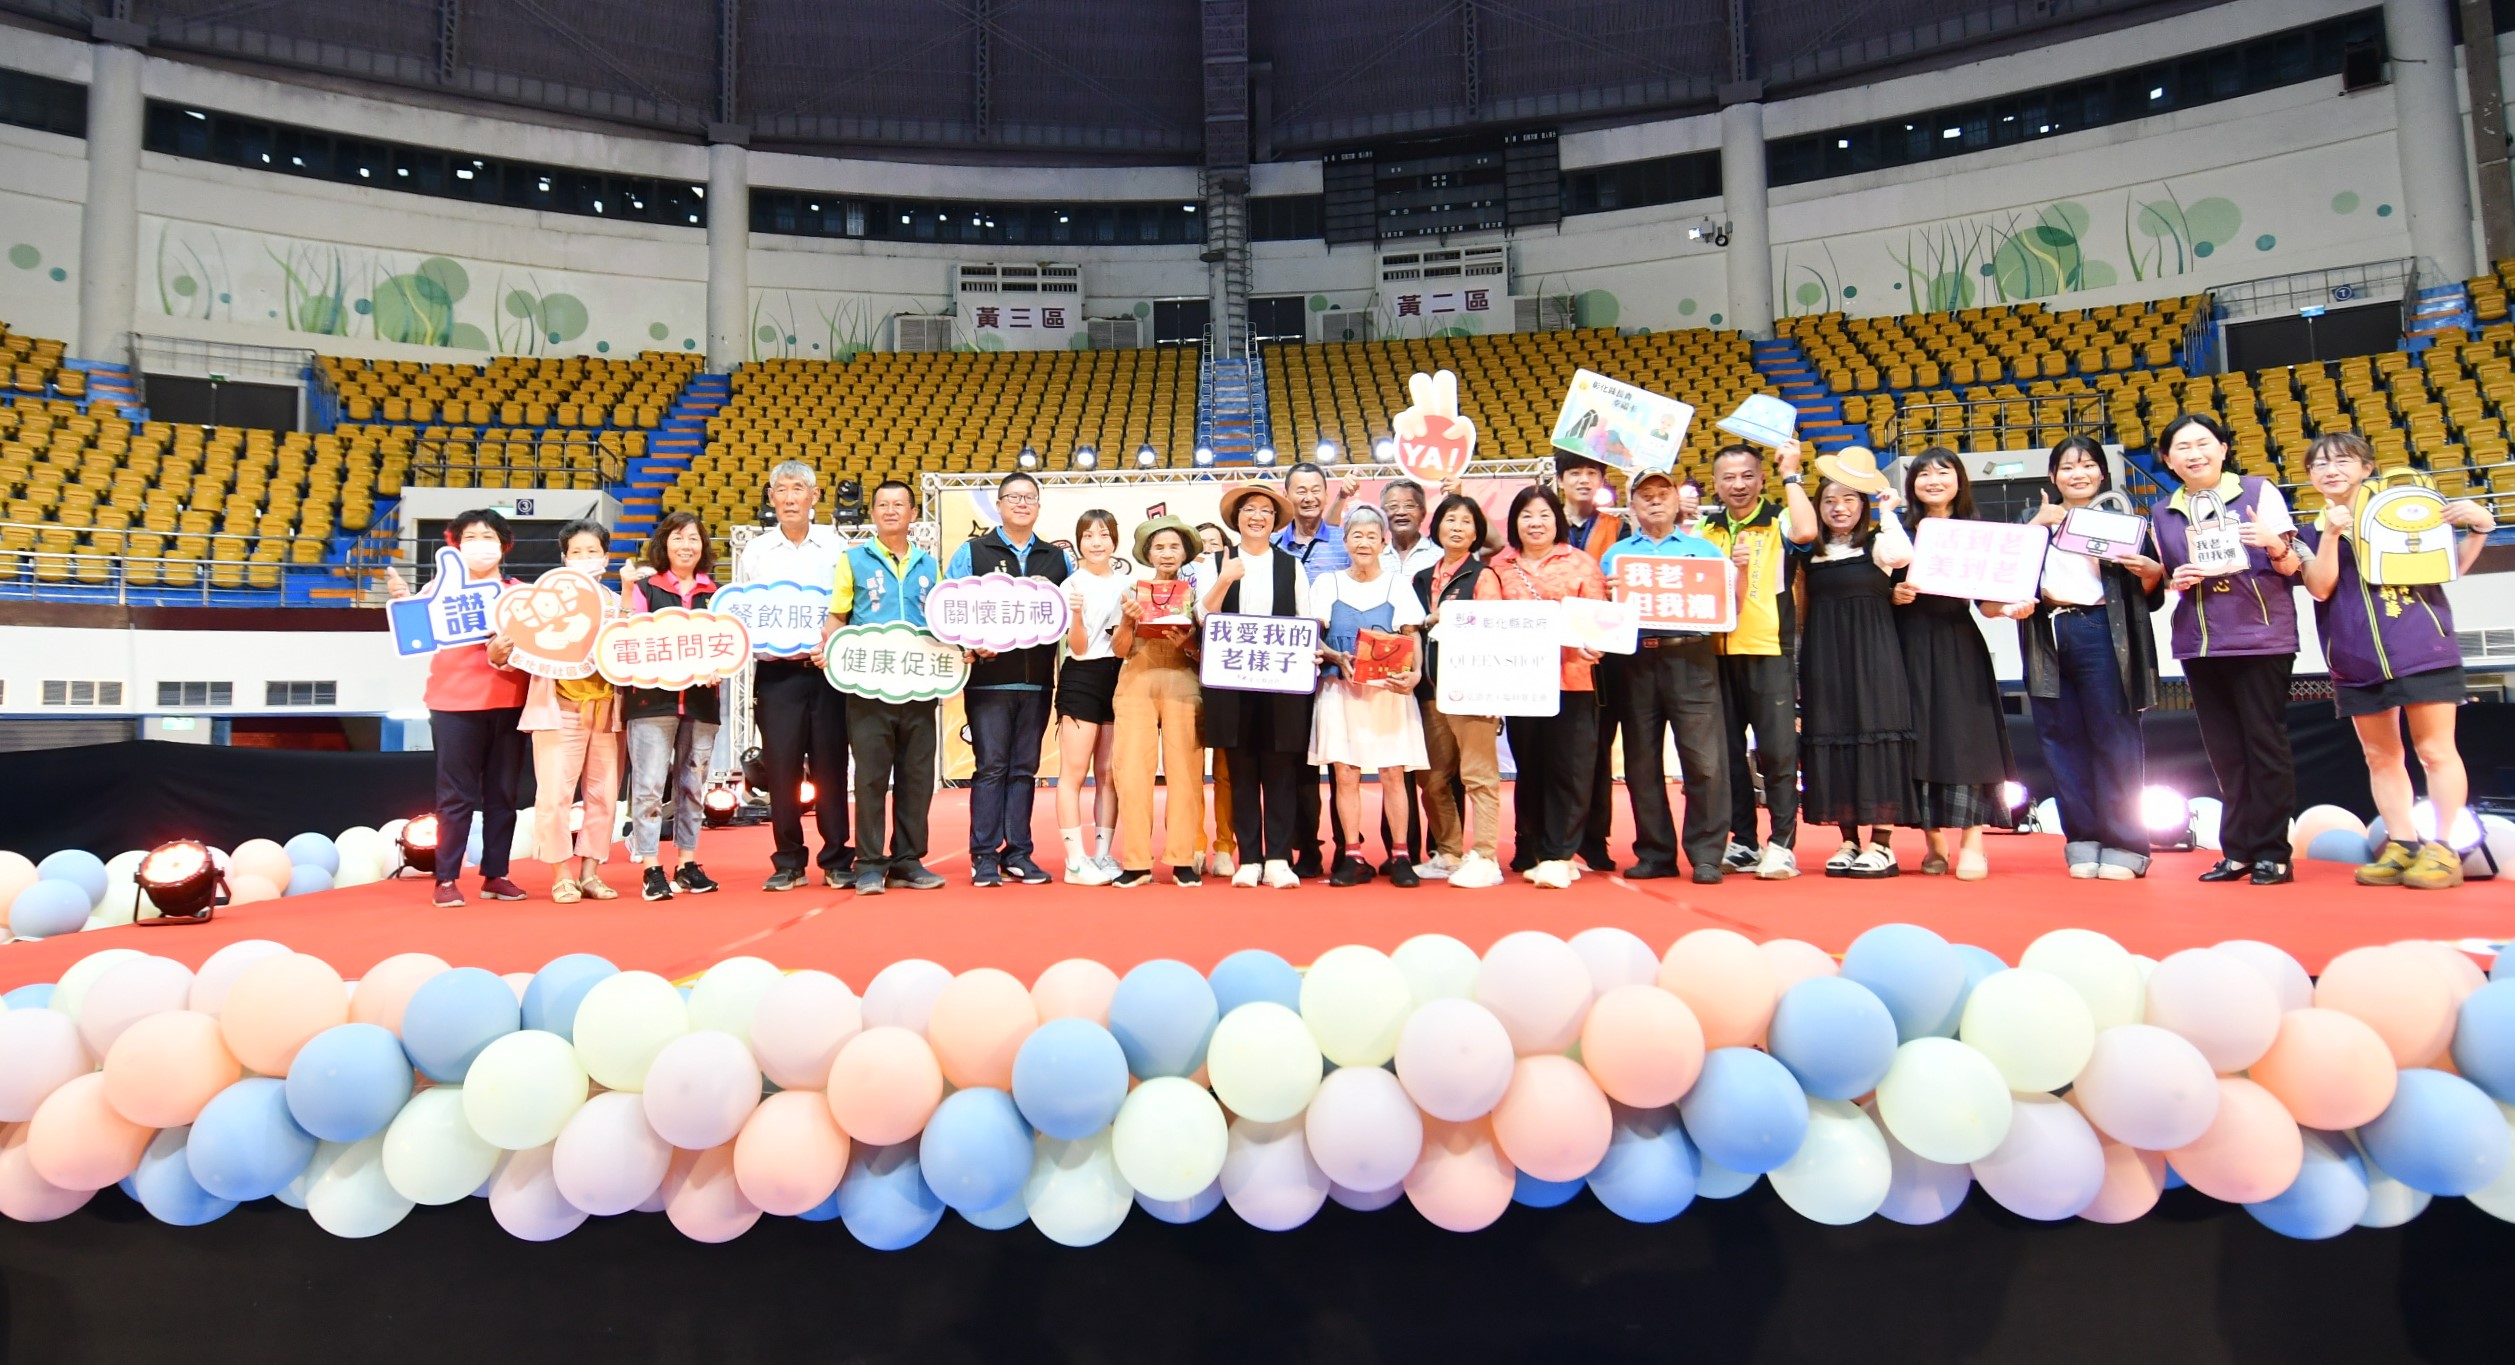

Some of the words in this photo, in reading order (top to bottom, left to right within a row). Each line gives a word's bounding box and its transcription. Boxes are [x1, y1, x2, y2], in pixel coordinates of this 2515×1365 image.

[1397, 289, 1489, 317] 黃二區
[976, 306, 1065, 328] 黃三區
[1402, 442, 1459, 473] YA!
[944, 600, 1055, 625] 關懷訪視
[1625, 592, 1716, 619] 但我潮
[1209, 620, 1312, 647] 我愛我的
[613, 632, 735, 665] 電話問安
[1221, 648, 1297, 673] 老樣子
[841, 647, 955, 678] 健康促進
